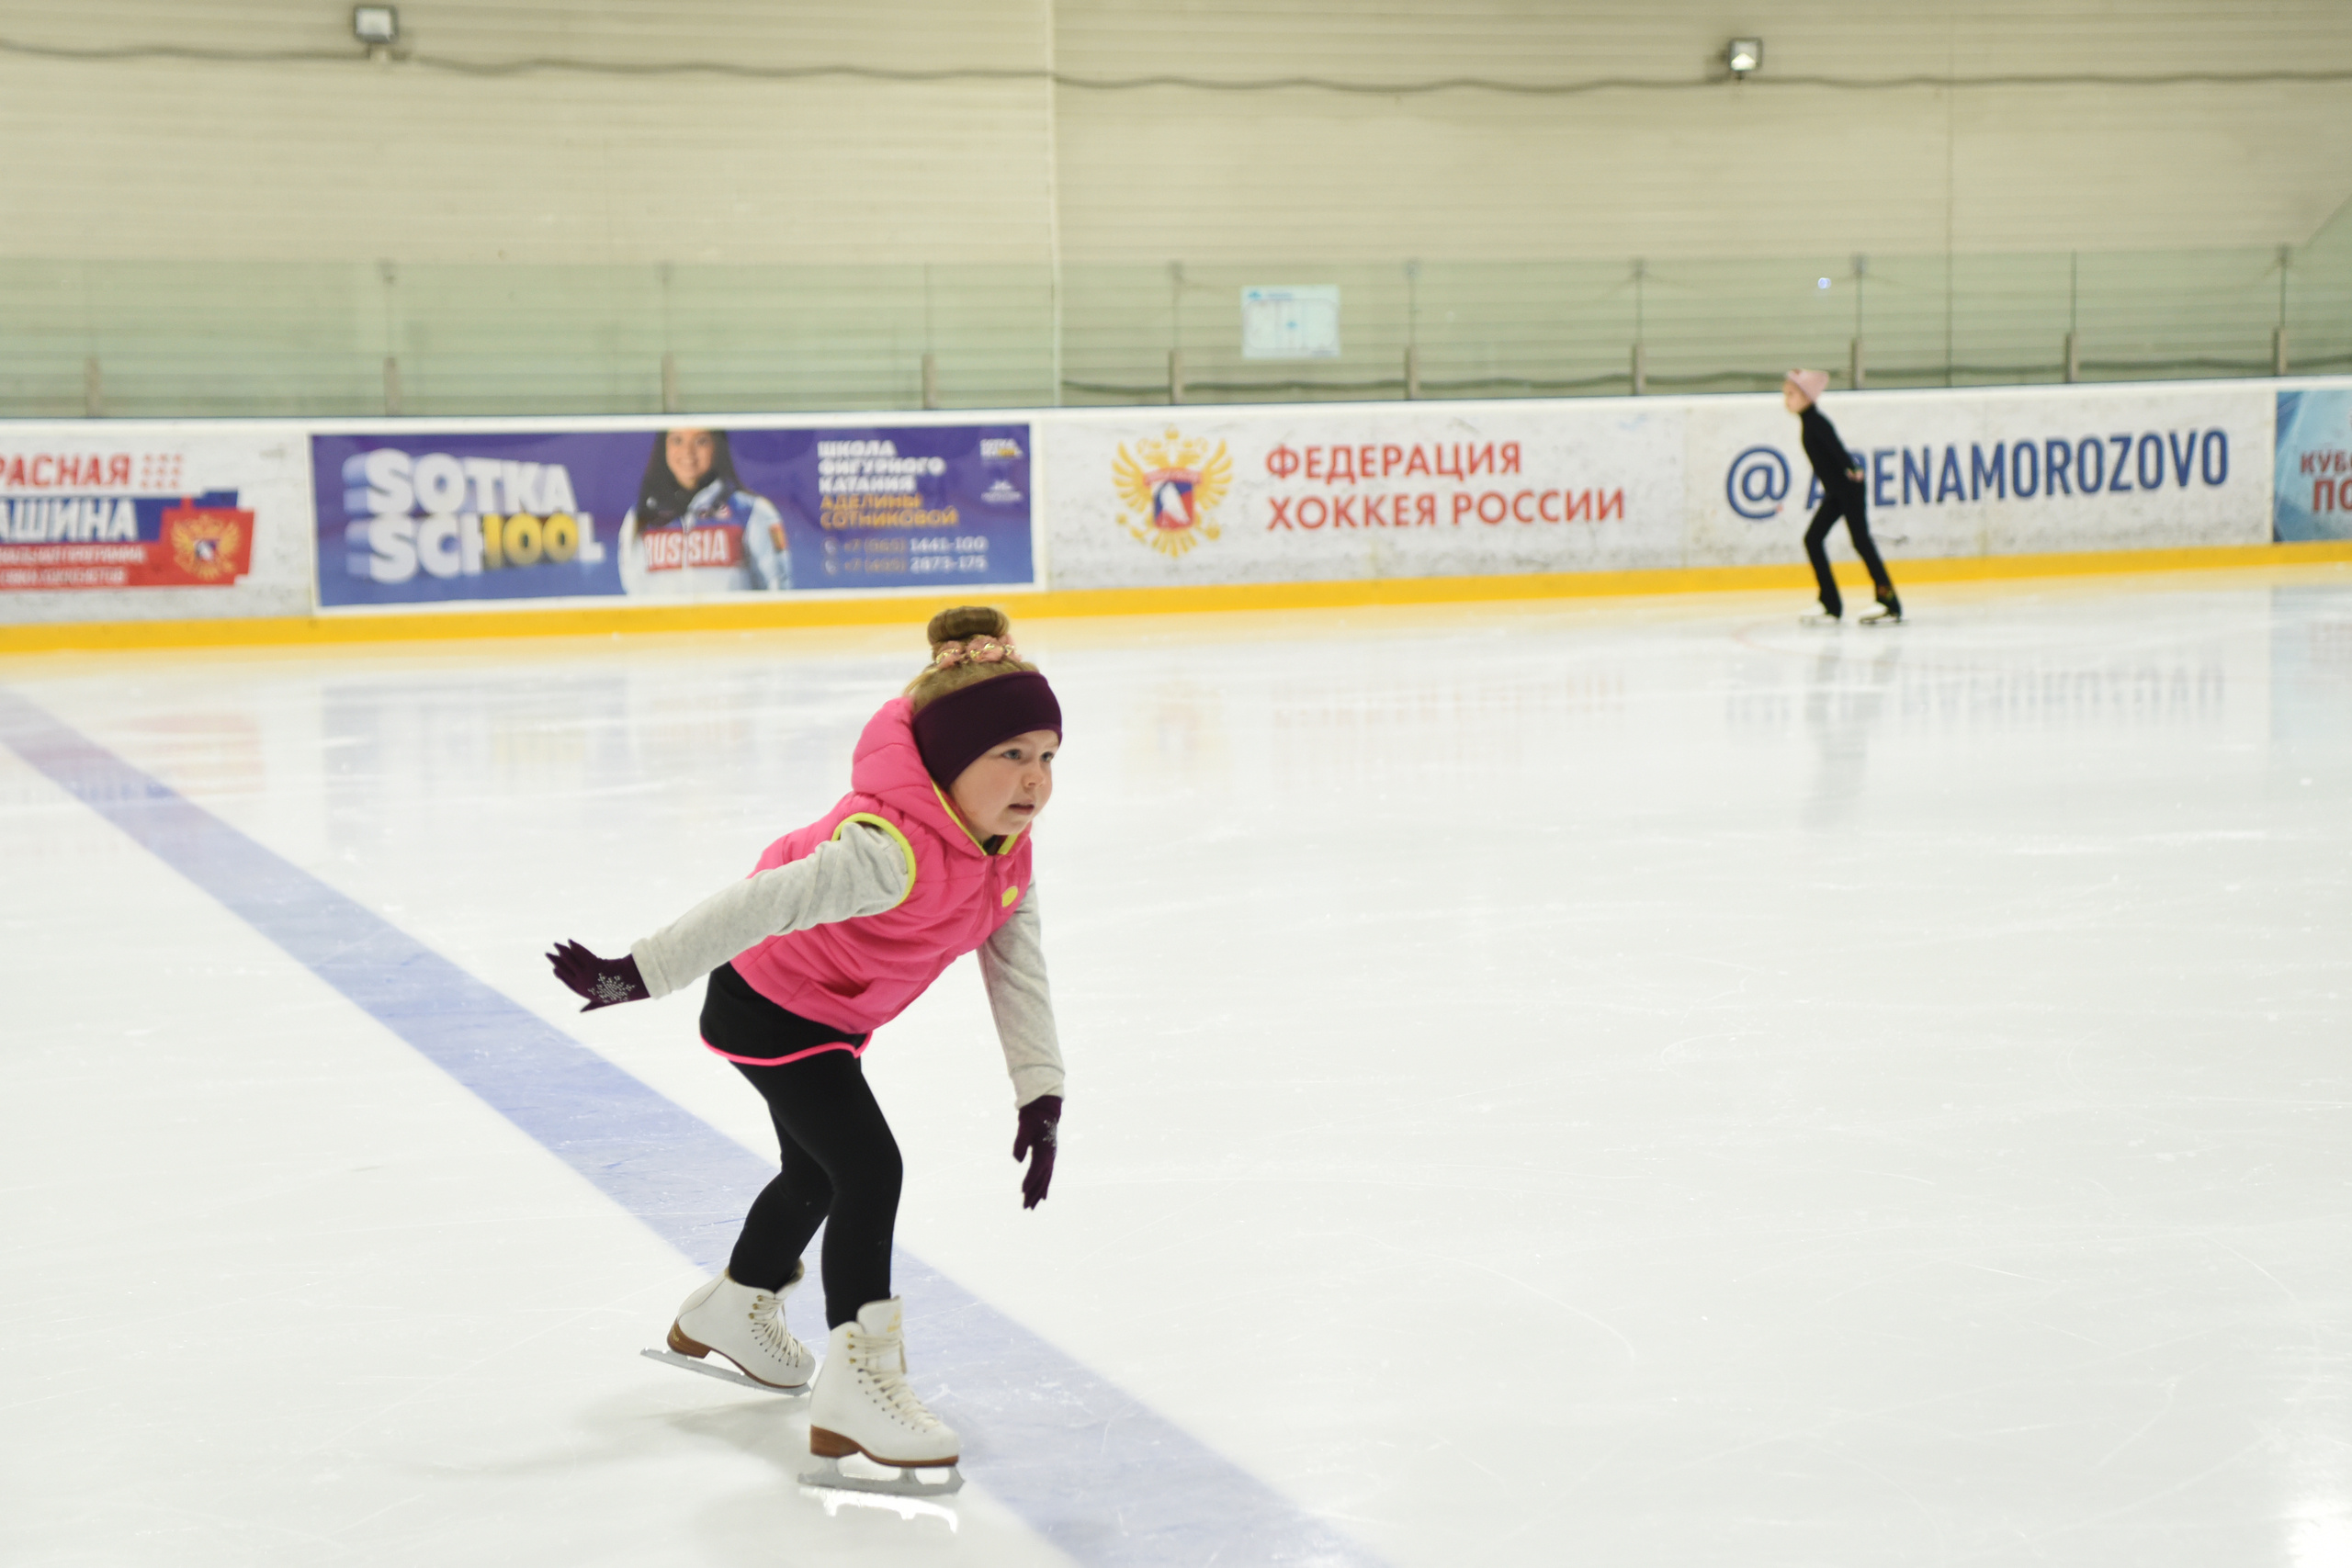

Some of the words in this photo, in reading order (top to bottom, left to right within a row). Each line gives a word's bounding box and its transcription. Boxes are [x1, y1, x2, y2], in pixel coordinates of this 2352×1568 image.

[818, 440, 897, 457] ШКОЛА
[1265, 441, 1521, 485] ФЕДЕРАЦИЯ
[2301, 448, 2352, 474] КУБ
[0, 453, 131, 489] АСНАЯ
[343, 448, 578, 514] SOTKA
[820, 507, 958, 528] СОТНИКОВОЙ
[1267, 492, 1436, 530] ХОККЕЯ
[1452, 488, 1626, 525] РОССИИ
[644, 530, 729, 566] RUSSIA
